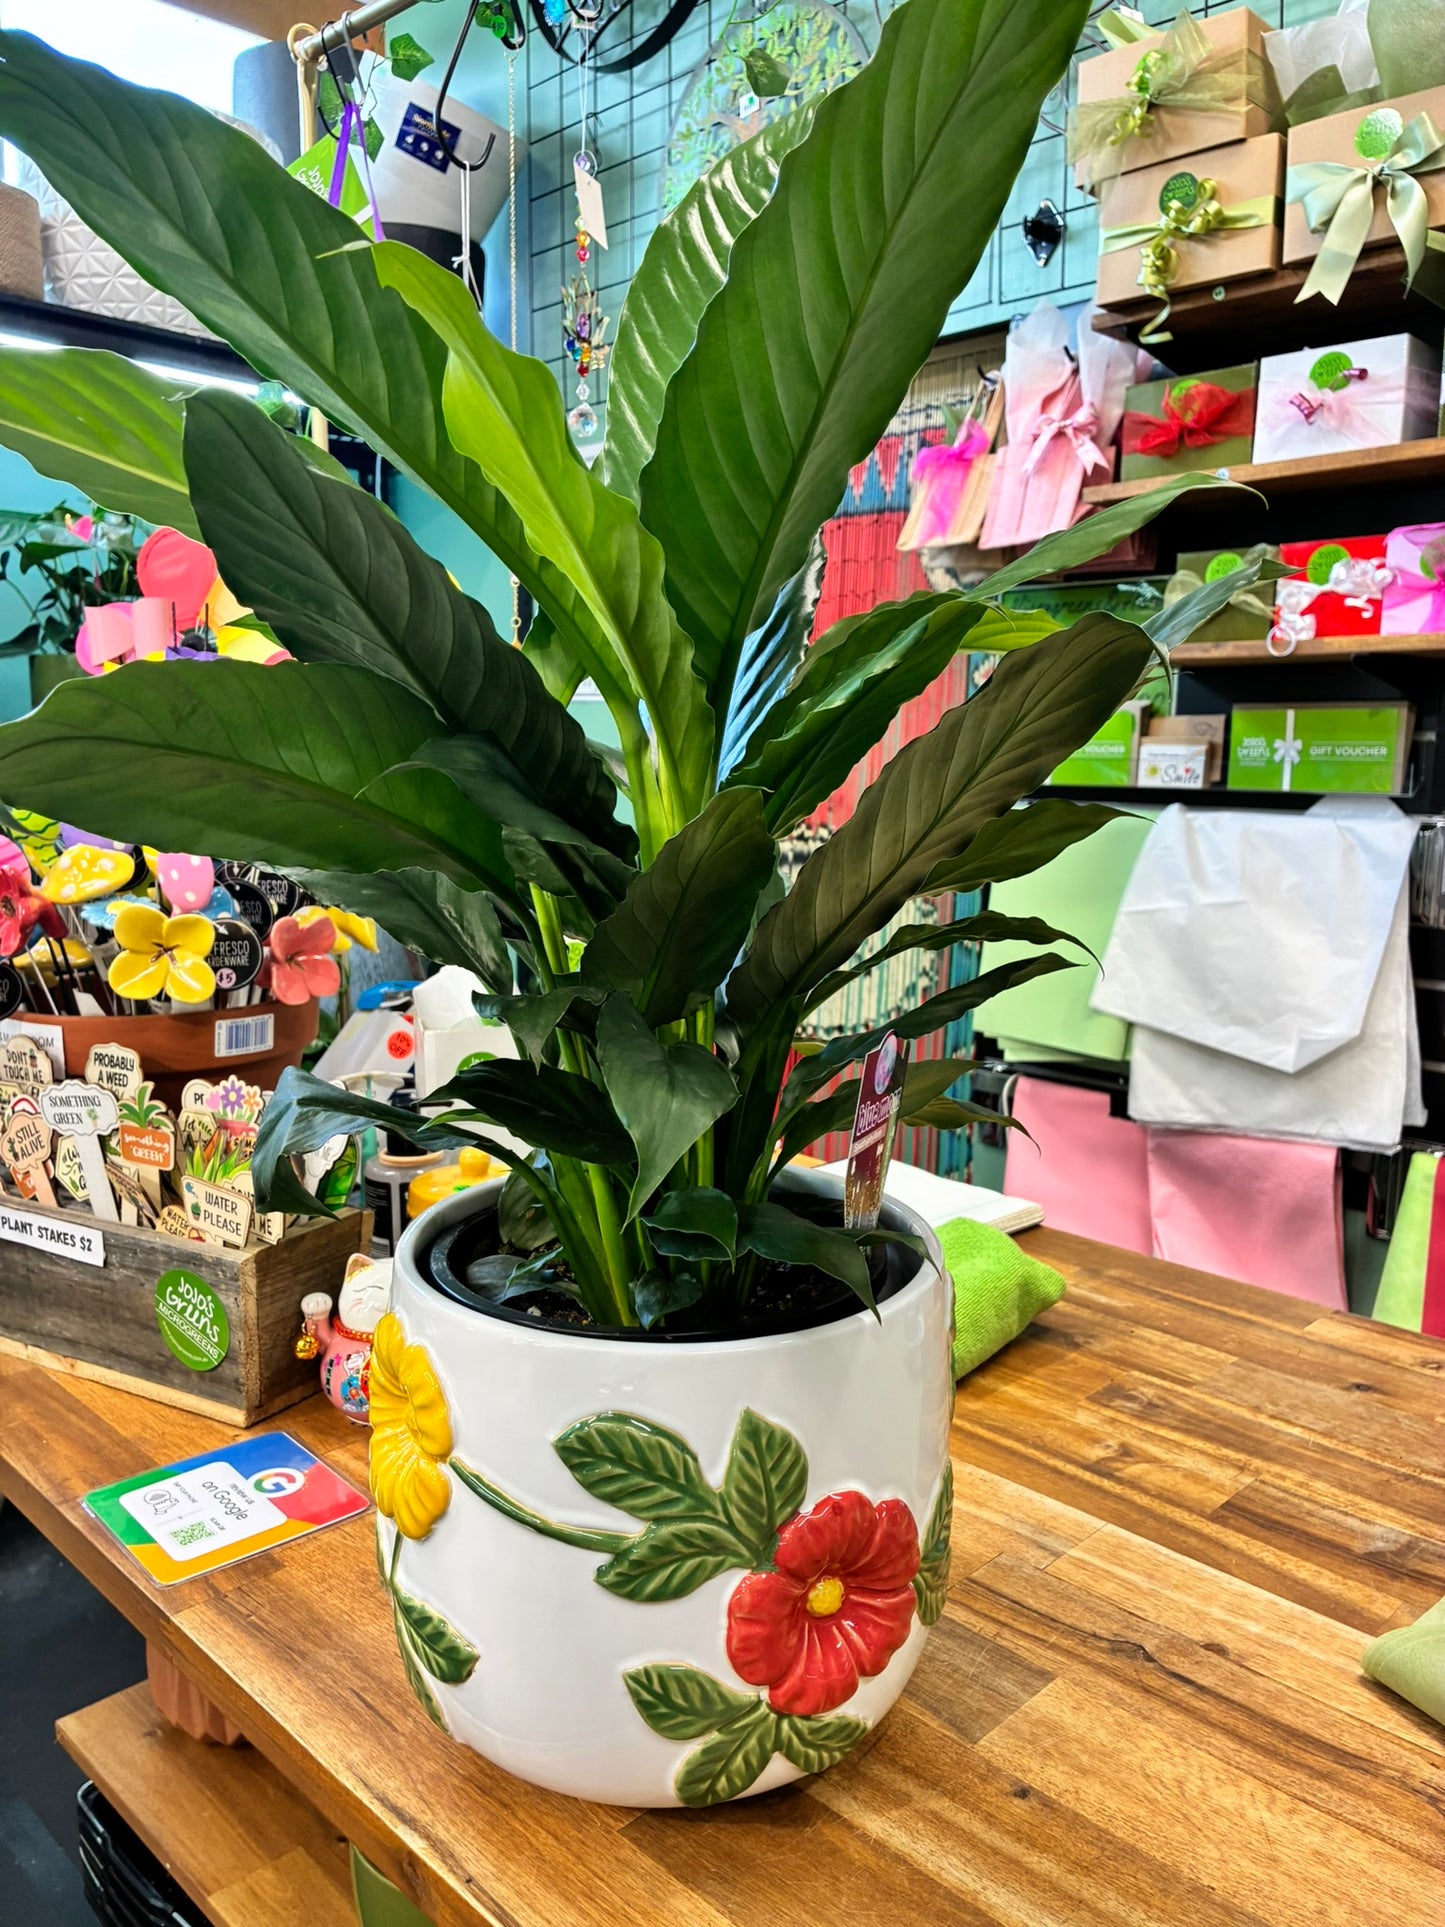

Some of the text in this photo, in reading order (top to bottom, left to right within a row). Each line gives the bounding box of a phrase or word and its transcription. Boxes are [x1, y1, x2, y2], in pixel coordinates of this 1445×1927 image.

[1309, 744, 1388, 757] GIFT VOUCHER
[214, 940, 250, 956] FRESCO
[207, 954, 250, 967] ARDENWARE
[98, 1069, 129, 1088] A WEED
[48, 1094, 101, 1108] SOMETHING
[53, 1111, 84, 1126] GREEN
[15, 1121, 40, 1144] STILL
[20, 1134, 46, 1160] ALIVE
[205, 1190, 238, 1216] WATER
[1, 1215, 94, 1252] PLANT STAKES $2
[203, 1208, 242, 1237] PLEASE
[158, 1302, 220, 1360] MICROGREENS
[201, 1481, 249, 1521] on Google
